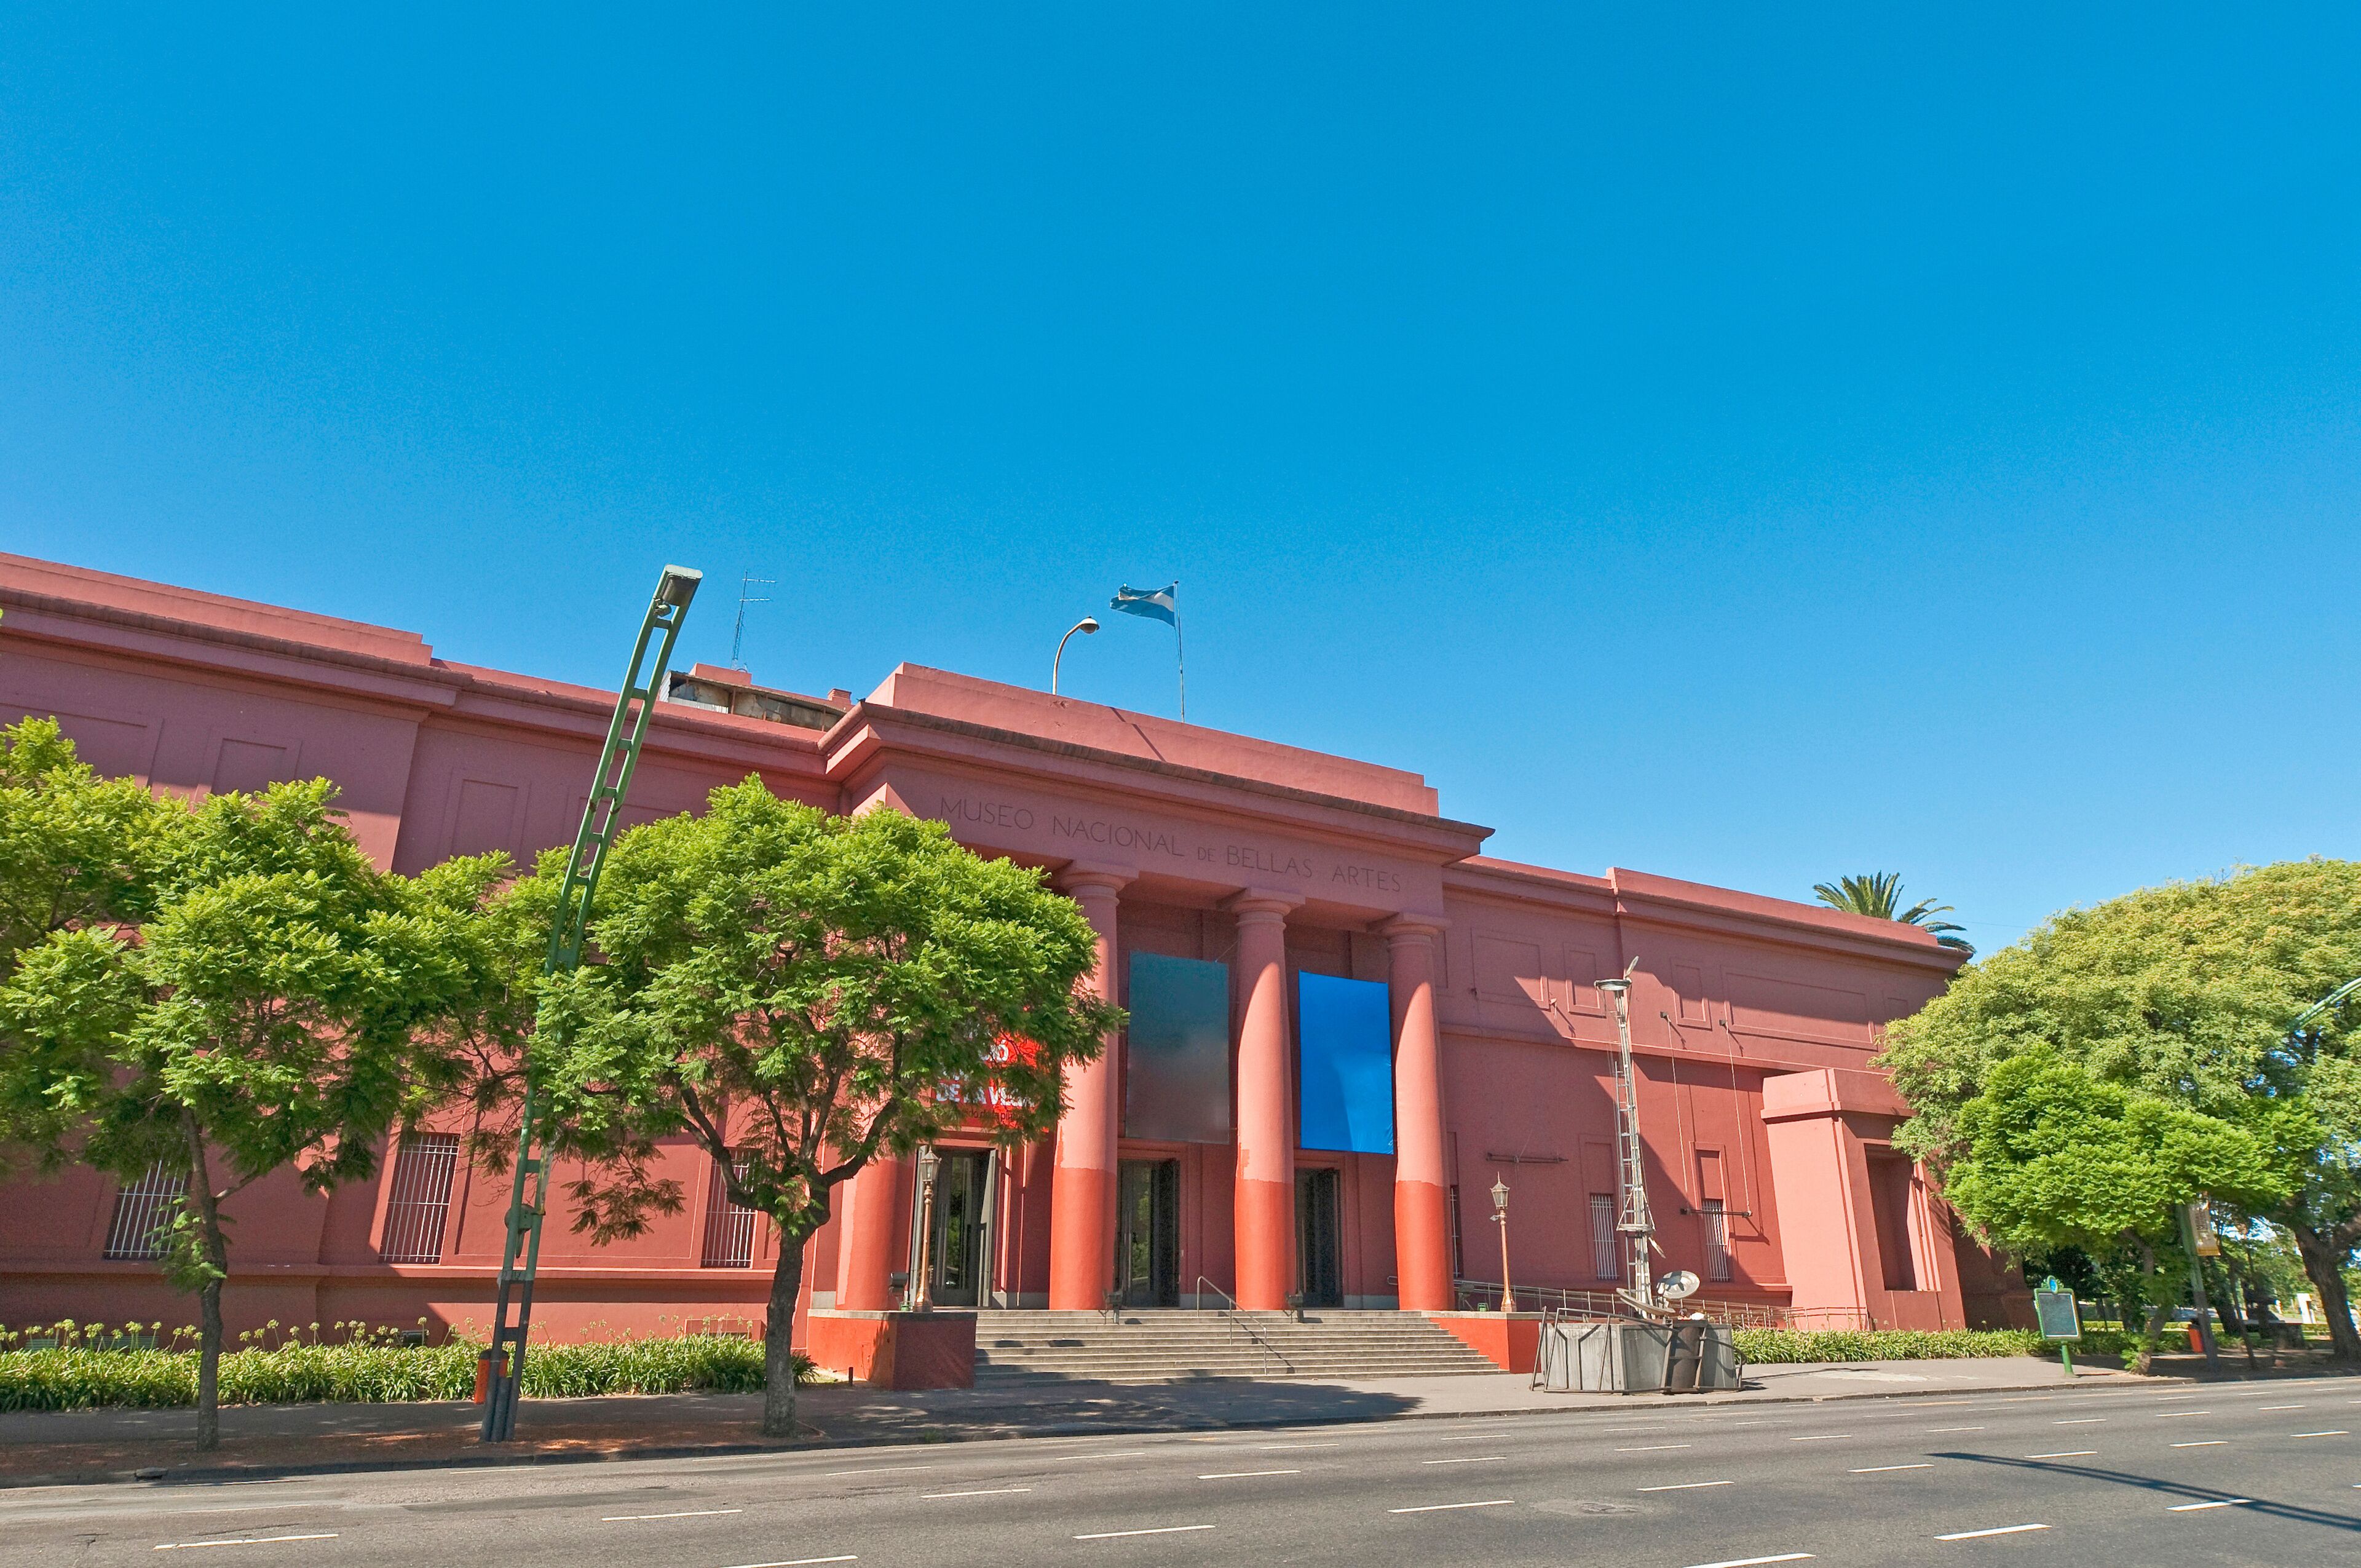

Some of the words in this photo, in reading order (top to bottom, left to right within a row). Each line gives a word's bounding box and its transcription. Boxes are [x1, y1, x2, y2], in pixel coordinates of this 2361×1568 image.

[941, 798, 1034, 830] MUSEO
[1053, 815, 1185, 857] NACIONAL
[1197, 847, 1216, 862] DE
[1227, 845, 1313, 878] BELLAS
[1332, 866, 1401, 892] ARTES
